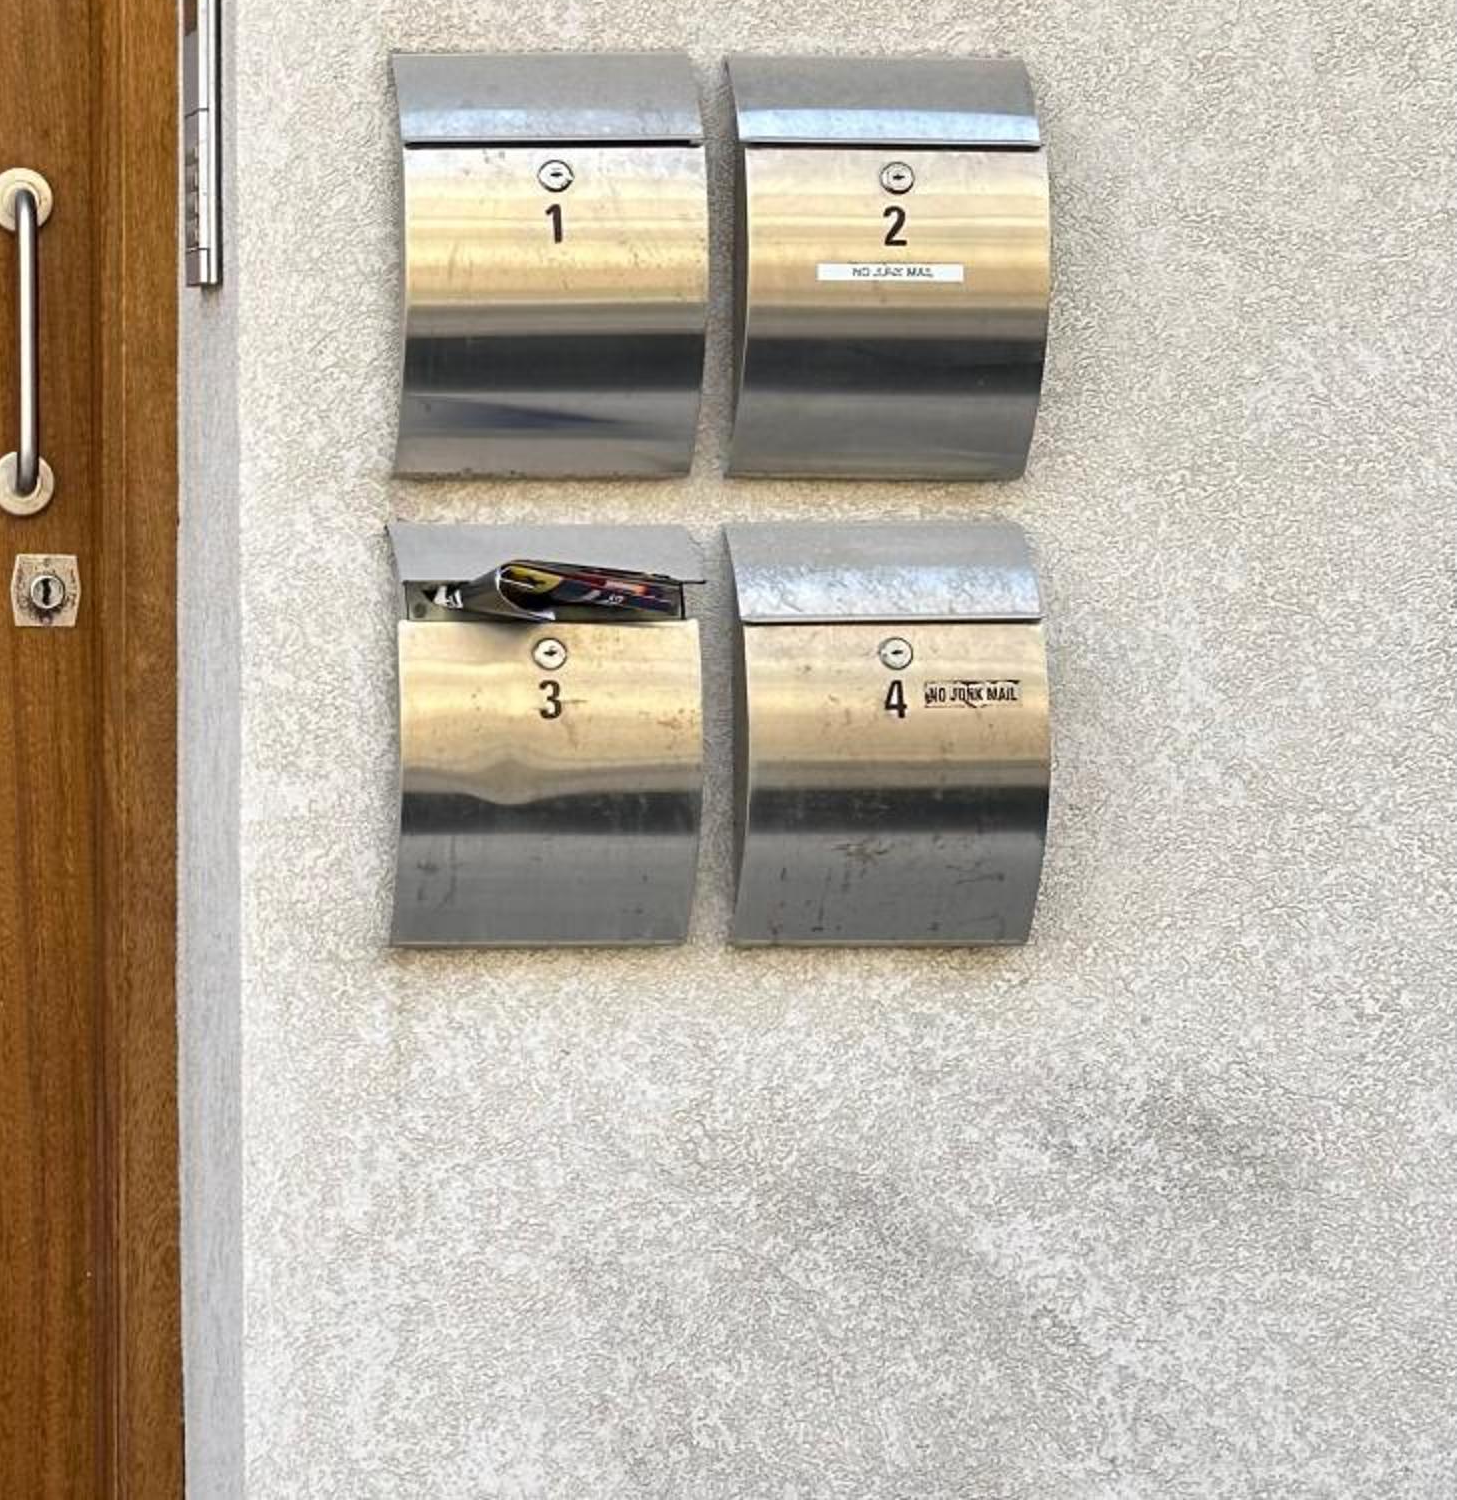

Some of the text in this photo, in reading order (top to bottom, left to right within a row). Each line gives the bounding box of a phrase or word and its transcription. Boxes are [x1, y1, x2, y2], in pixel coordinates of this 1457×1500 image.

[545, 203, 563, 244] 1
[883, 205, 908, 247] 2
[539, 679, 563, 719] 3
[884, 679, 908, 719] 4
[928, 687, 946, 703] NO
[986, 687, 1018, 701] MAIL
